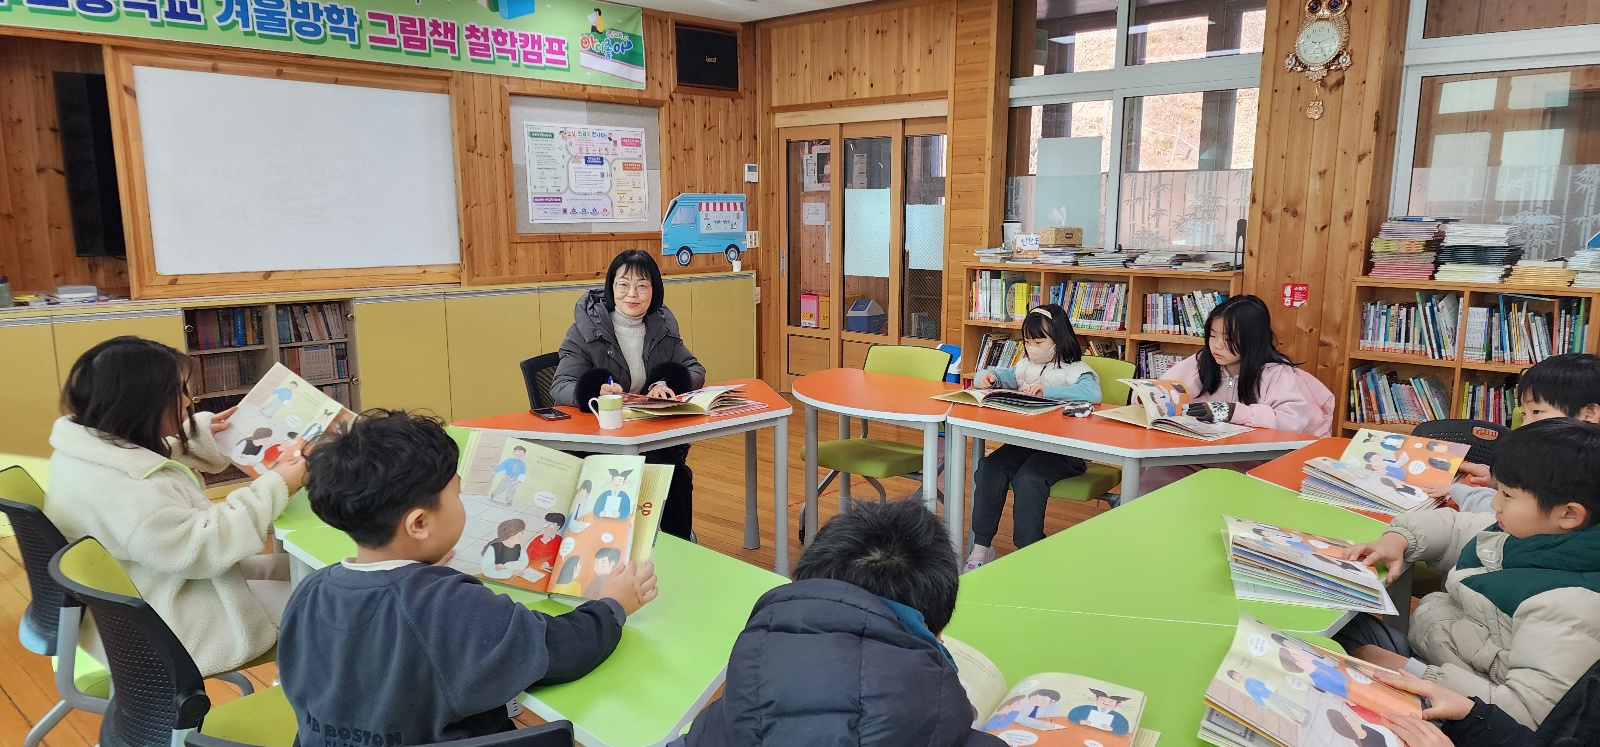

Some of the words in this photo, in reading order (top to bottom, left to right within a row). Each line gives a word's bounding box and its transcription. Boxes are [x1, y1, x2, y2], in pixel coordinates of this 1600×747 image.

[215, 0, 359, 44] 겨울방학
[367, 11, 459, 56] 그림책
[464, 23, 568, 68] 철학캠프
[580, 34, 633, 61] 아이좋아
[324, 724, 402, 747] BOSTON
